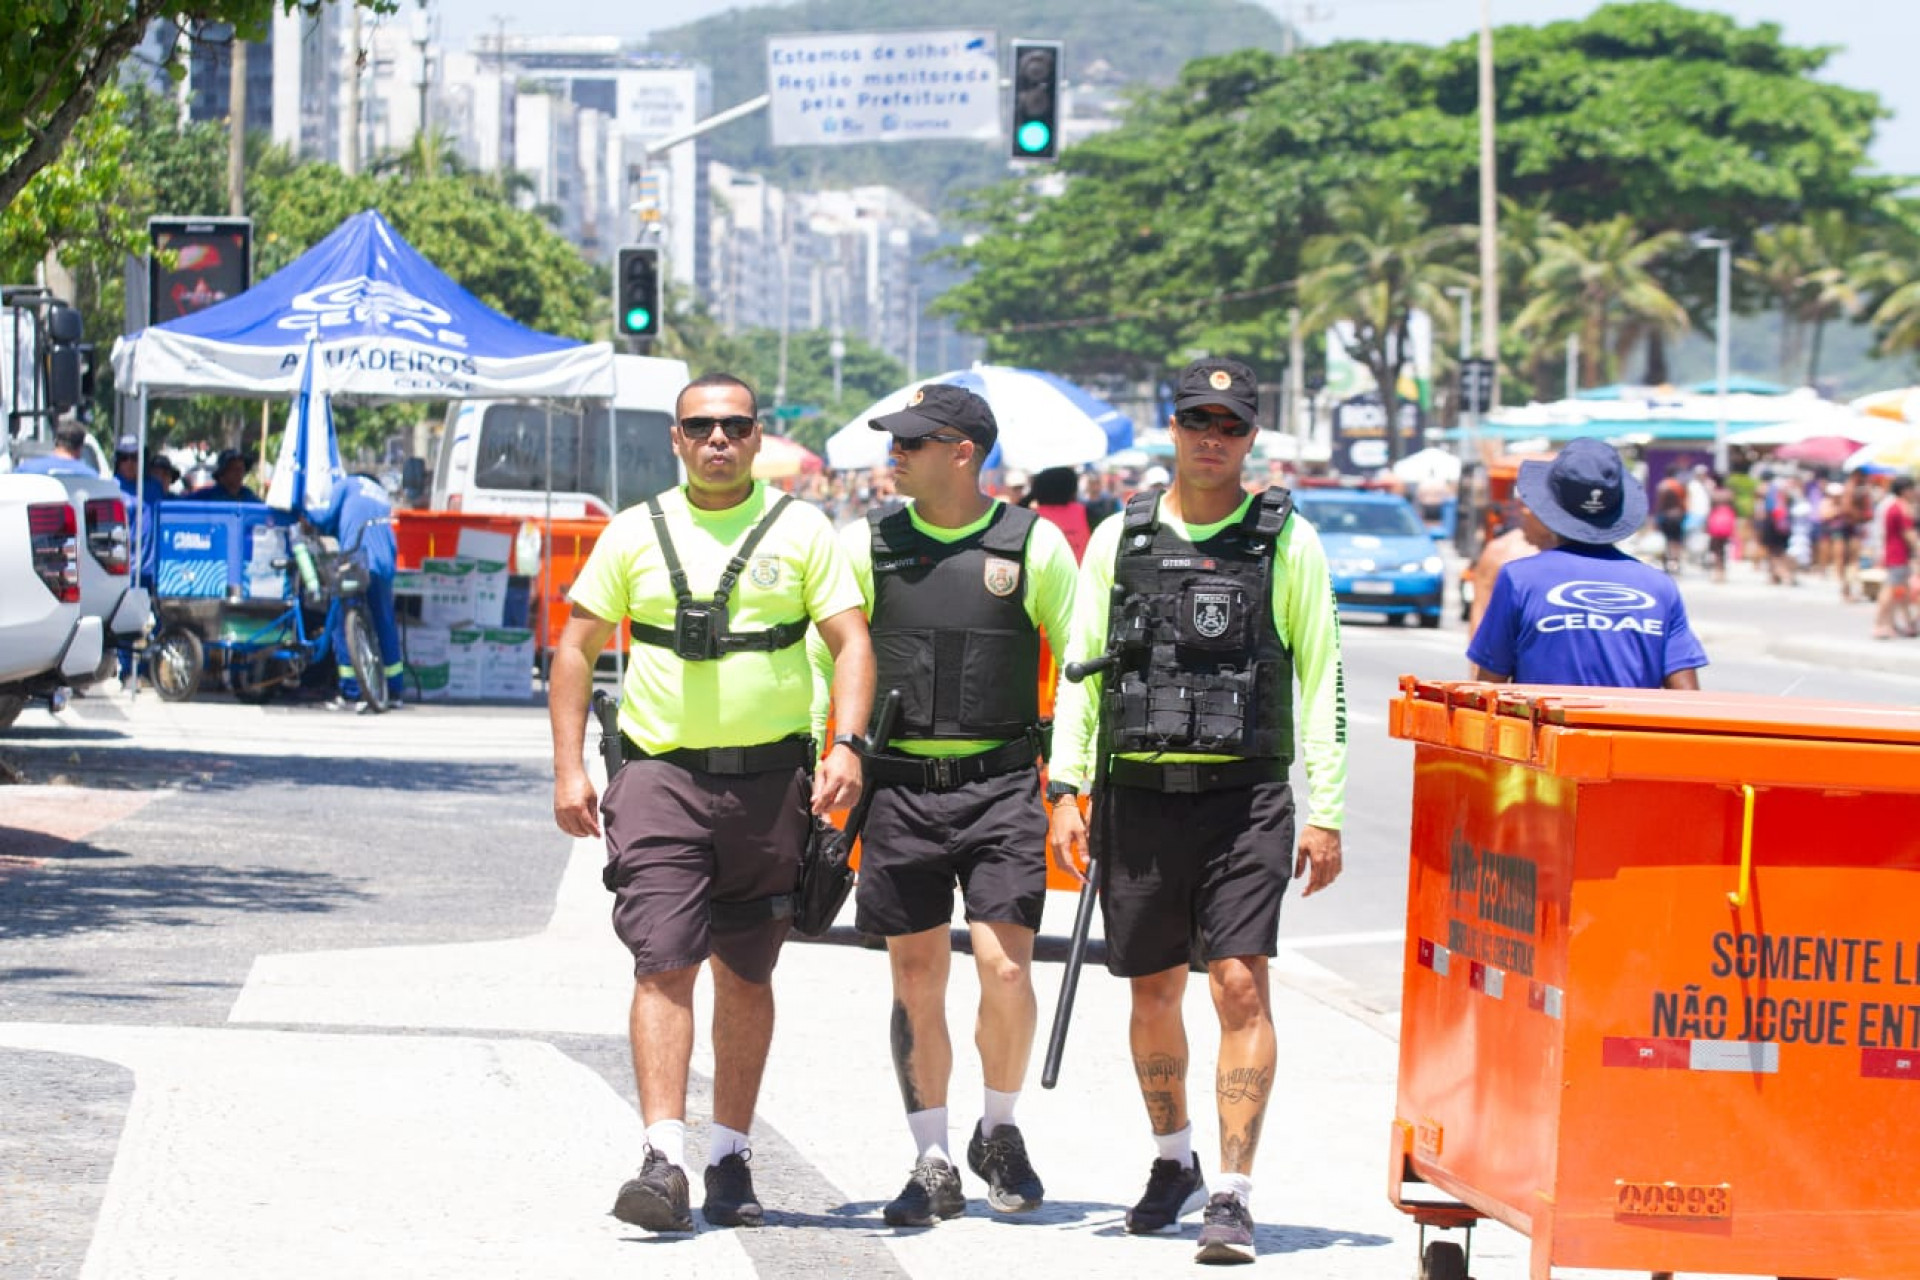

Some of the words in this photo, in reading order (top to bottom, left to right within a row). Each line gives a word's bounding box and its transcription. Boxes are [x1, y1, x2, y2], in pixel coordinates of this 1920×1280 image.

[773, 48, 860, 65] Estamos
[873, 45, 895, 60] de
[779, 73, 852, 93] Região
[864, 67, 988, 86] monitorada
[801, 95, 846, 113] pela
[857, 90, 967, 107] Prefeitura
[280, 348, 477, 376] AUADEIROS
[1536, 613, 1664, 636] CEDAE
[1711, 931, 1883, 985] SOMENTE
[1652, 984, 1728, 1039] NÃO
[1737, 997, 1848, 1046] JOGUE
